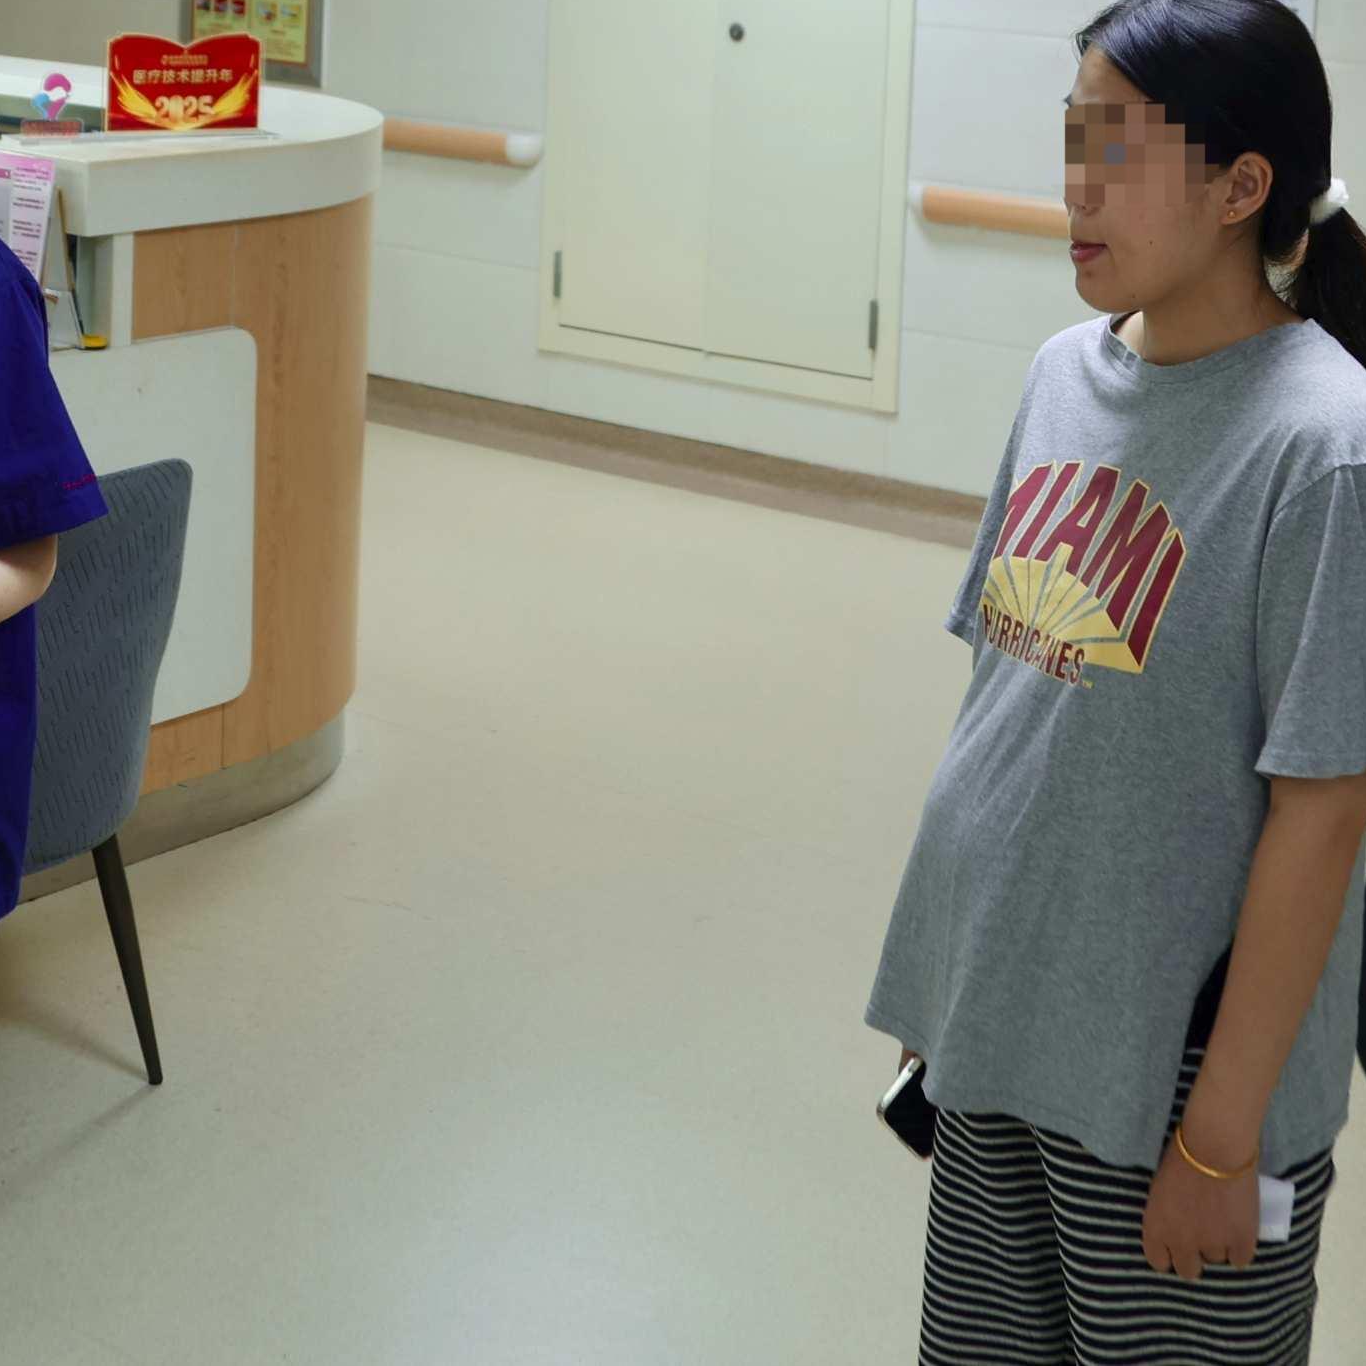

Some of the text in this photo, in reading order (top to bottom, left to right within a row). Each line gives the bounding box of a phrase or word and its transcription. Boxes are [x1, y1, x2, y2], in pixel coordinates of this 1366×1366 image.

[133, 69, 234, 84] 医疗技术提升年
[155, 95, 214, 123] 2025
